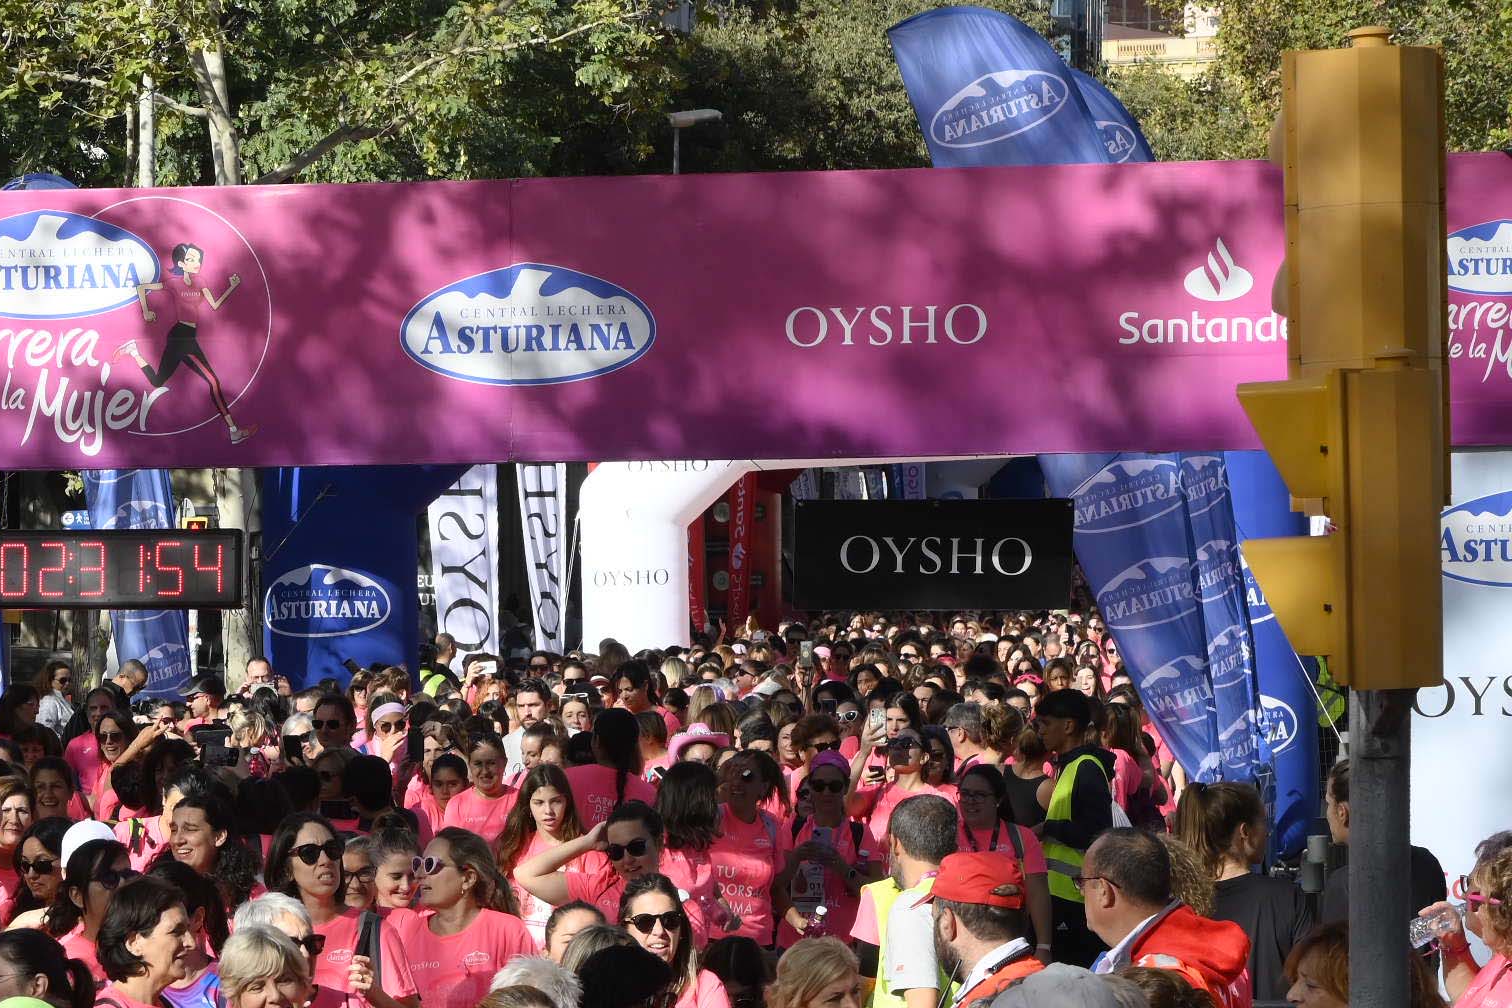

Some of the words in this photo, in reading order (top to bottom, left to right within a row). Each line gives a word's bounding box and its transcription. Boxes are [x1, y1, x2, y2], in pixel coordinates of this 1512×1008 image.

[460, 306, 538, 319] CENTRAL
[546, 304, 627, 317] LECHERA
[785, 303, 989, 348] OYSHO
[420, 311, 636, 355] ASTURIANA
[1469, 329, 1487, 358] la
[1, 370, 27, 411] la
[21, 363, 170, 457] Mujer
[0, 542, 224, 597] 02:31:54
[840, 536, 1034, 576] OYSHO
[593, 568, 670, 587] OYSHO
[268, 594, 382, 621] ASTURIANA
